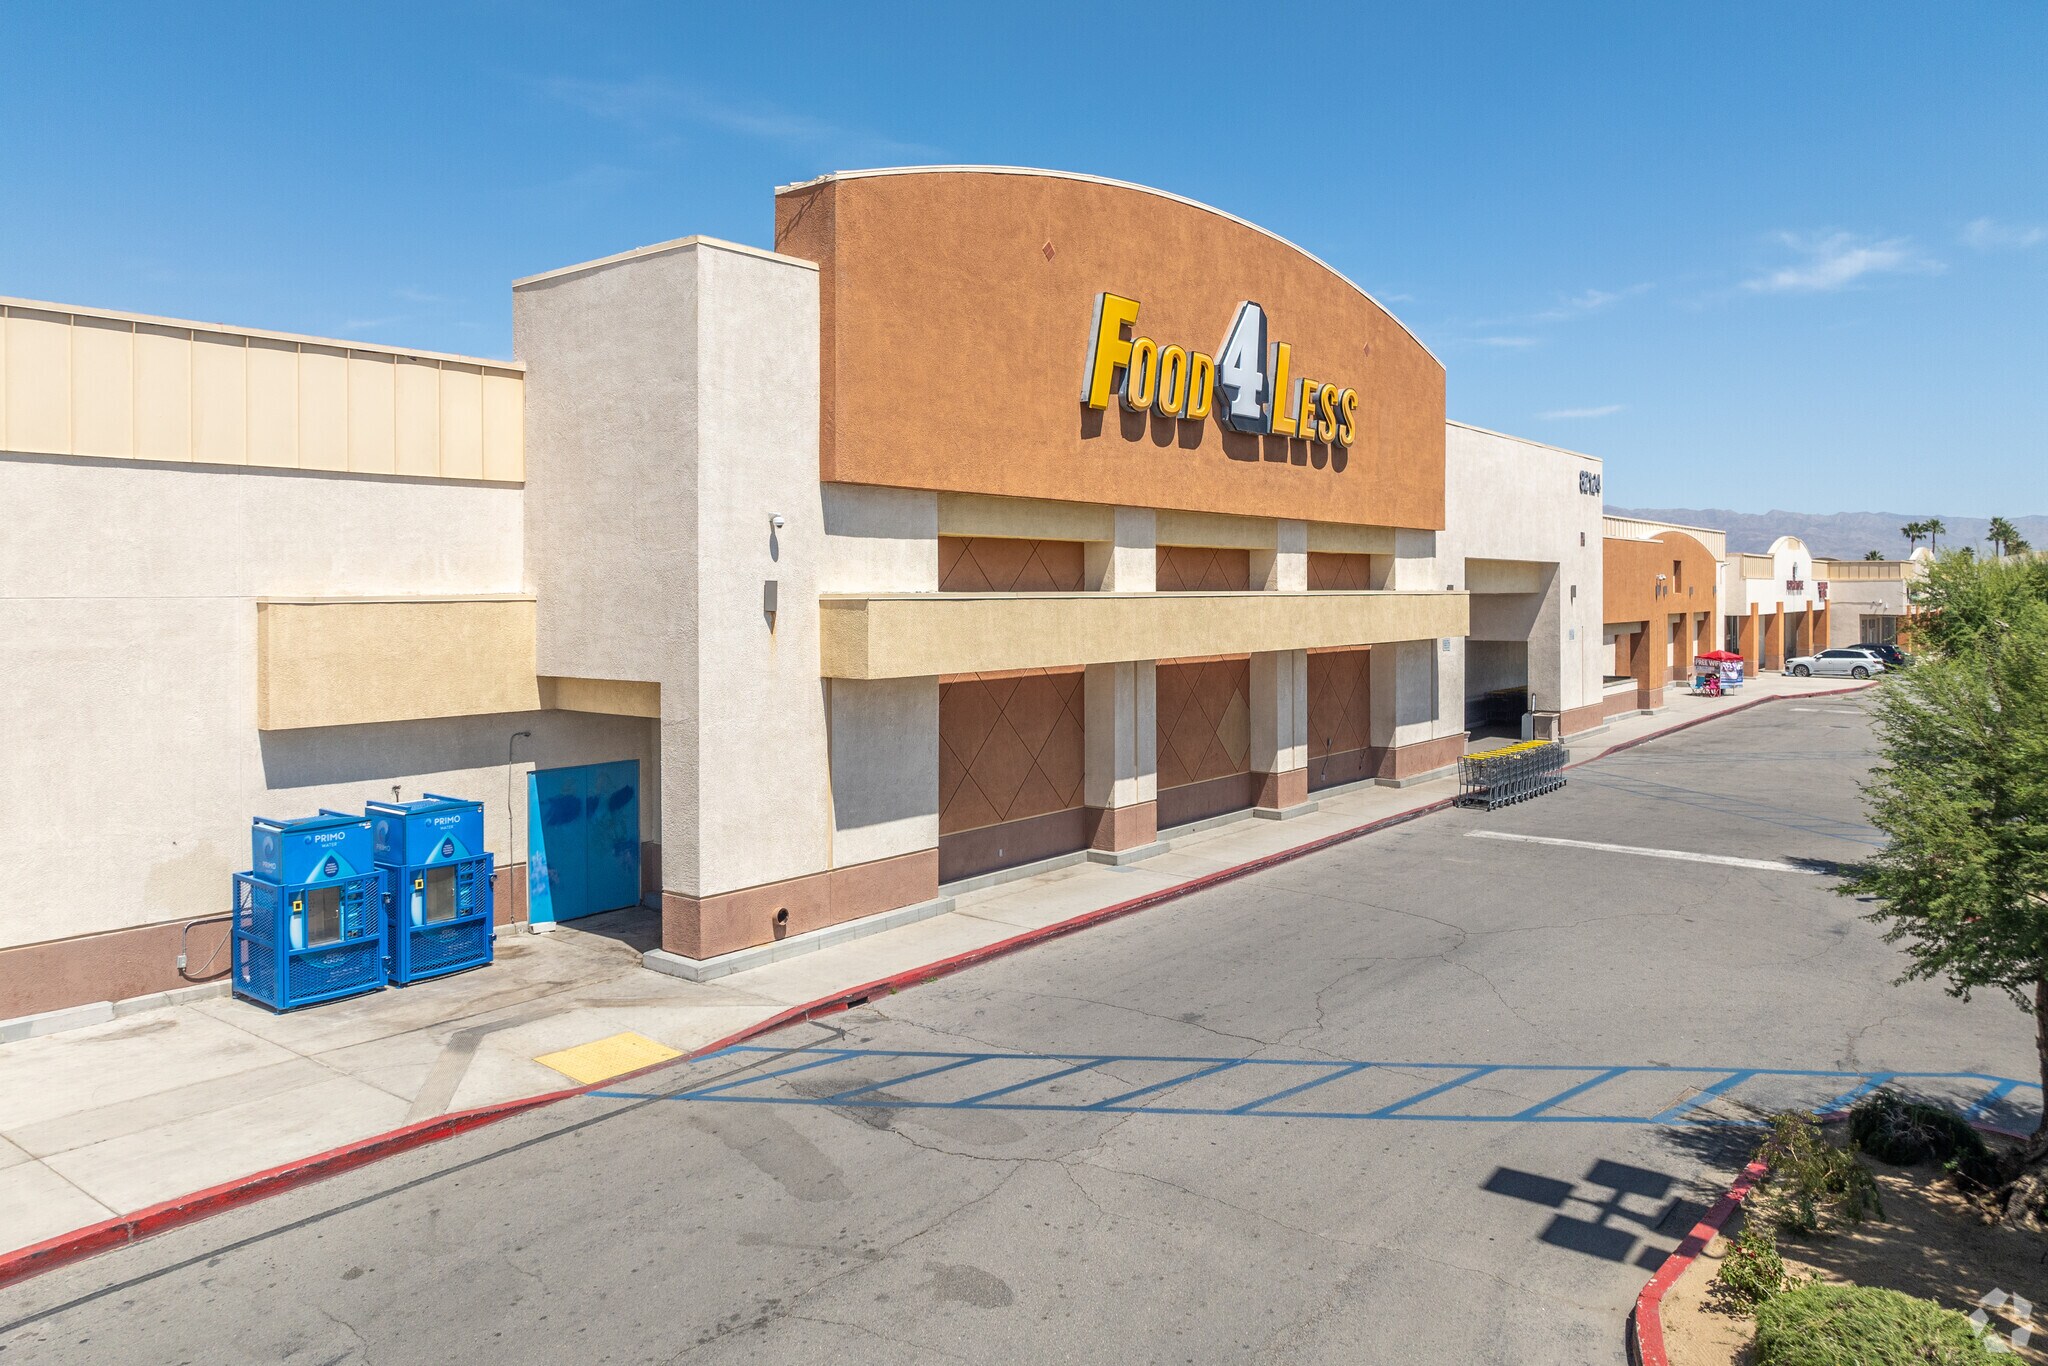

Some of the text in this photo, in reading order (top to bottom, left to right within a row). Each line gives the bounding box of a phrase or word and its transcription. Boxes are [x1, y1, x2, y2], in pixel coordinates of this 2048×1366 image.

[1082, 292, 1359, 449] FOOD 4 LESS
[434, 815, 461, 826] PRIMO
[314, 831, 346, 844] PRIMO
[262, 861, 277, 870] PRIMO
